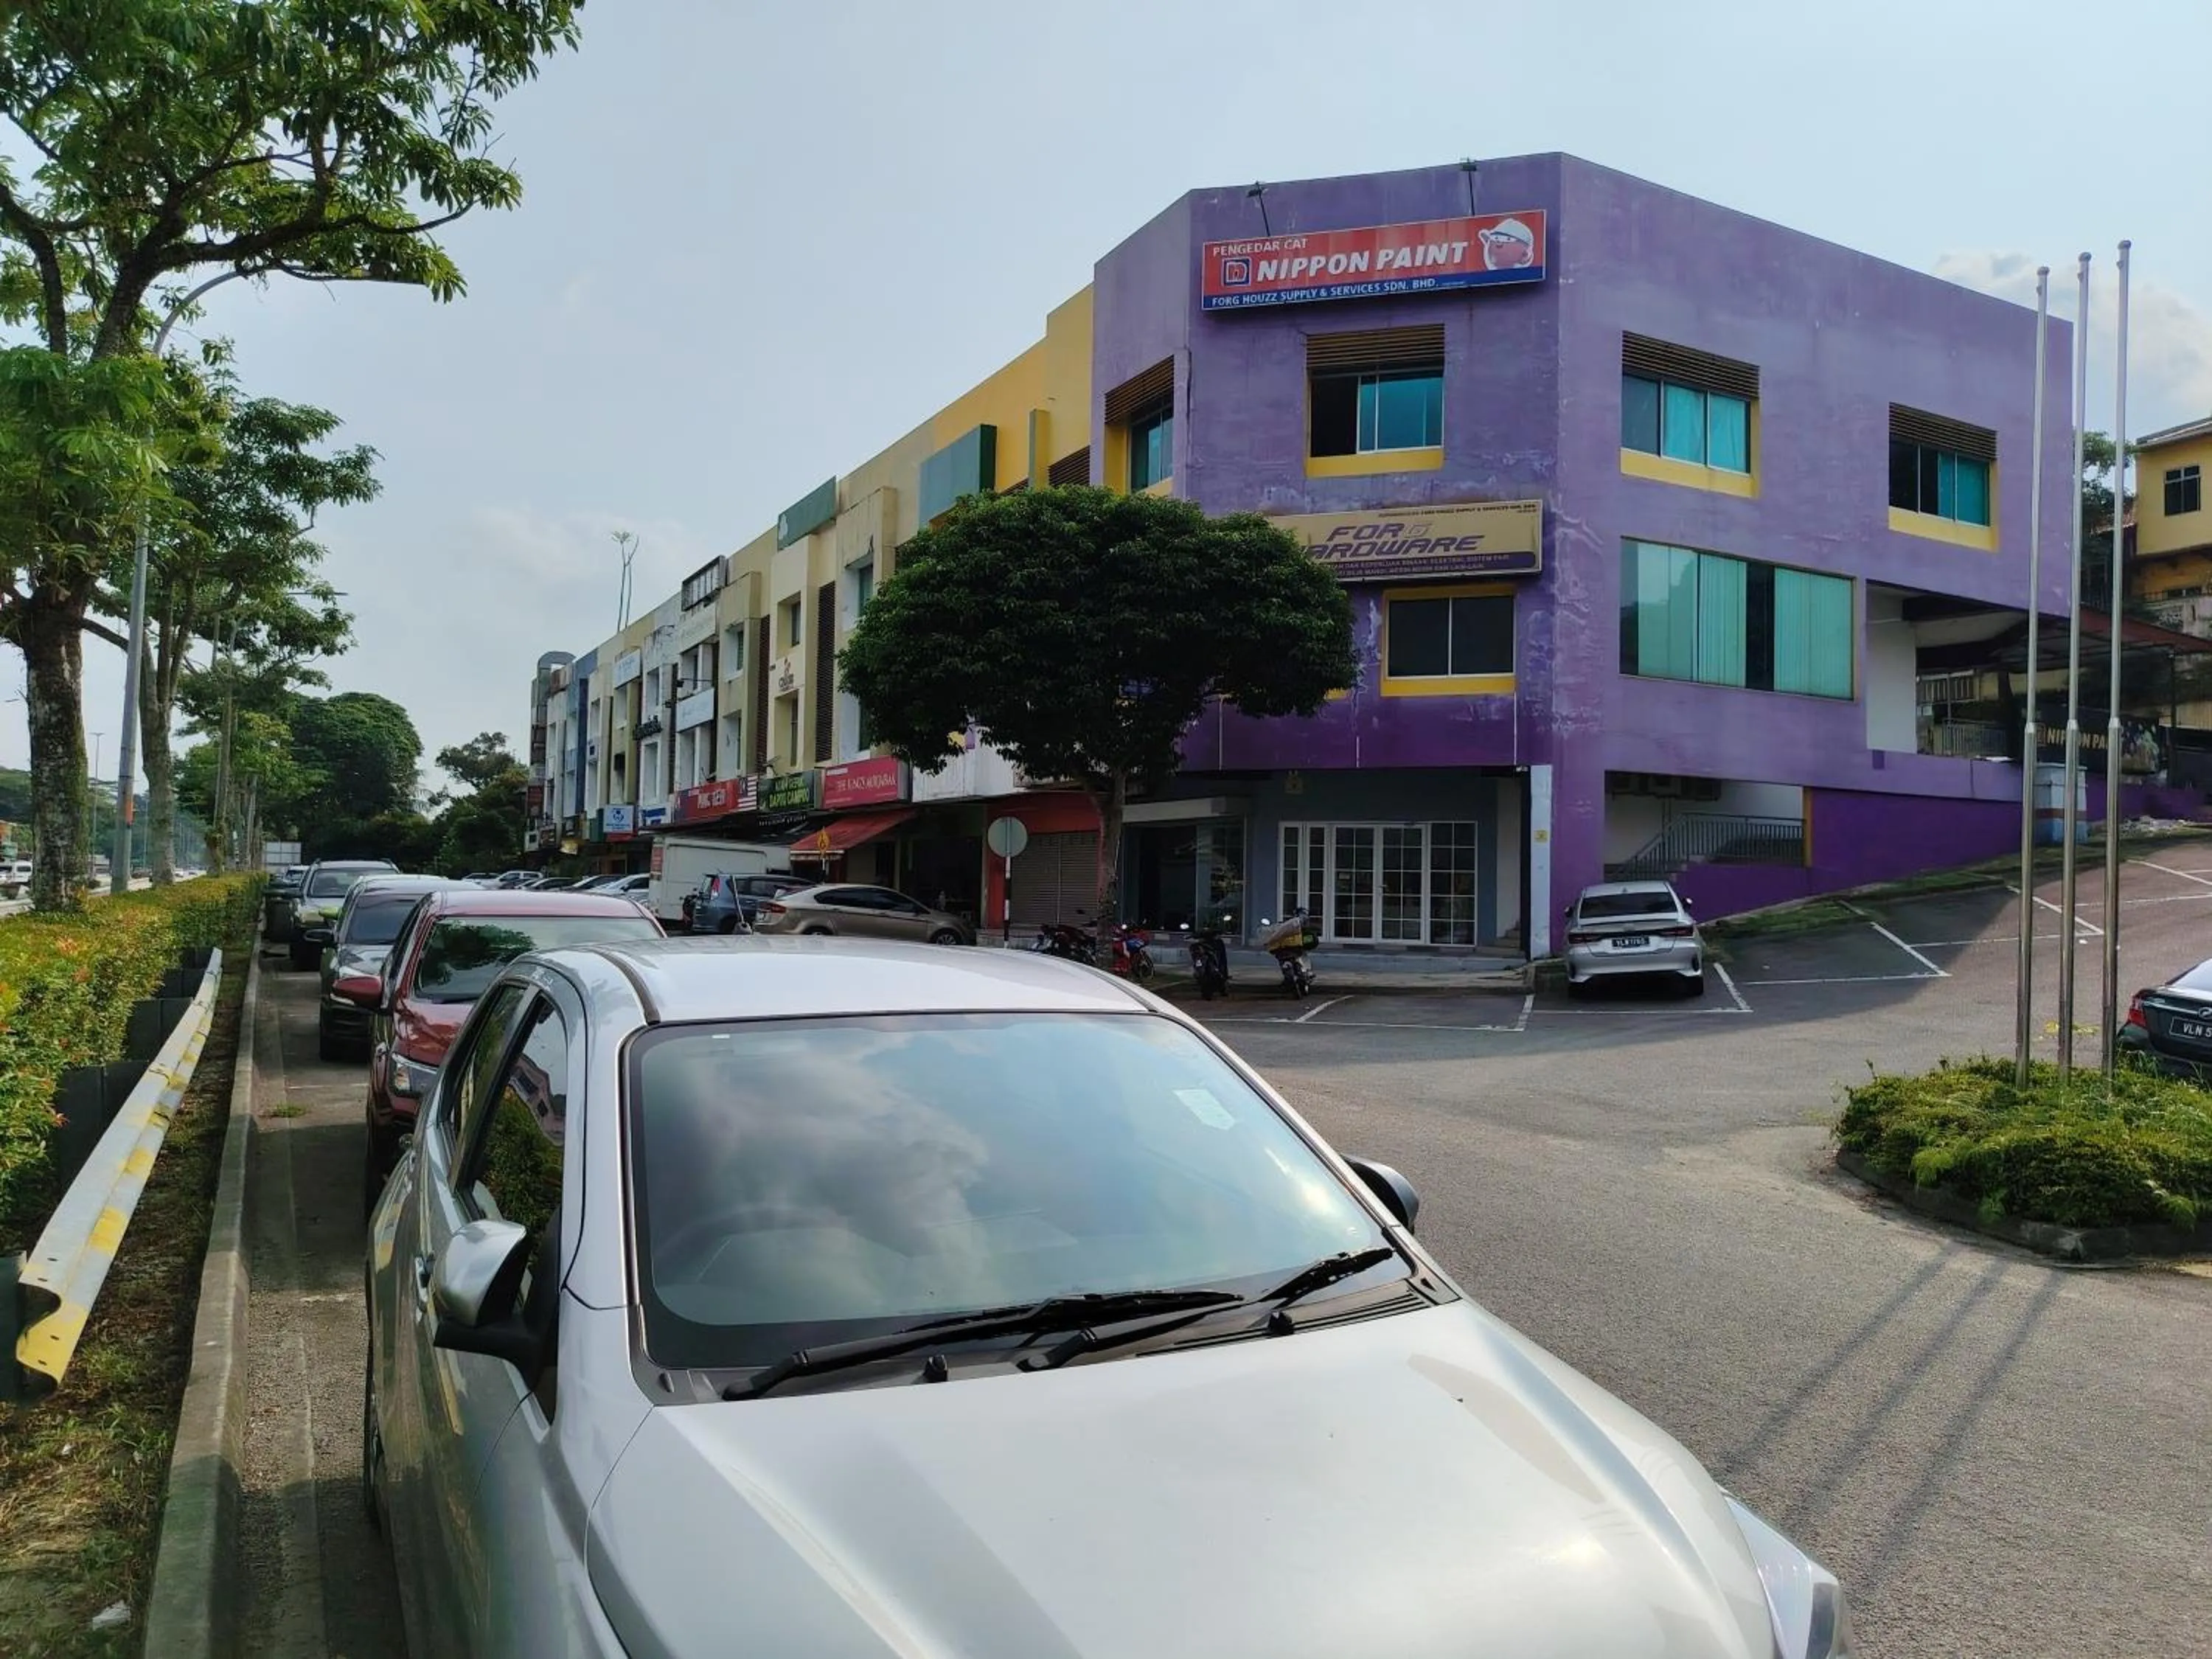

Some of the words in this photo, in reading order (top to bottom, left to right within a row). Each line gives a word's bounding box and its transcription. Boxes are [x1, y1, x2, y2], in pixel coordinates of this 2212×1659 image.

[1213, 241, 1280, 257] PENGEDAR
[1284, 238, 1308, 249] CAT
[1257, 251, 1369, 282] NIPPON
[1375, 241, 1468, 271] PAINT
[1212, 296, 1239, 307] FORG
[1242, 293, 1278, 305] HOUZZ
[1281, 288, 1318, 302] SUPPLY
[1320, 286, 1327, 296] &
[1329, 282, 1380, 296] SERVICES
[1384, 280, 1409, 292] SDN.
[1413, 278, 1438, 289] BHD.
[1301, 534, 1485, 559] ARDWARE
[2047, 727, 2091, 748] NIPN
[2183, 1023, 2202, 1036] VLN
